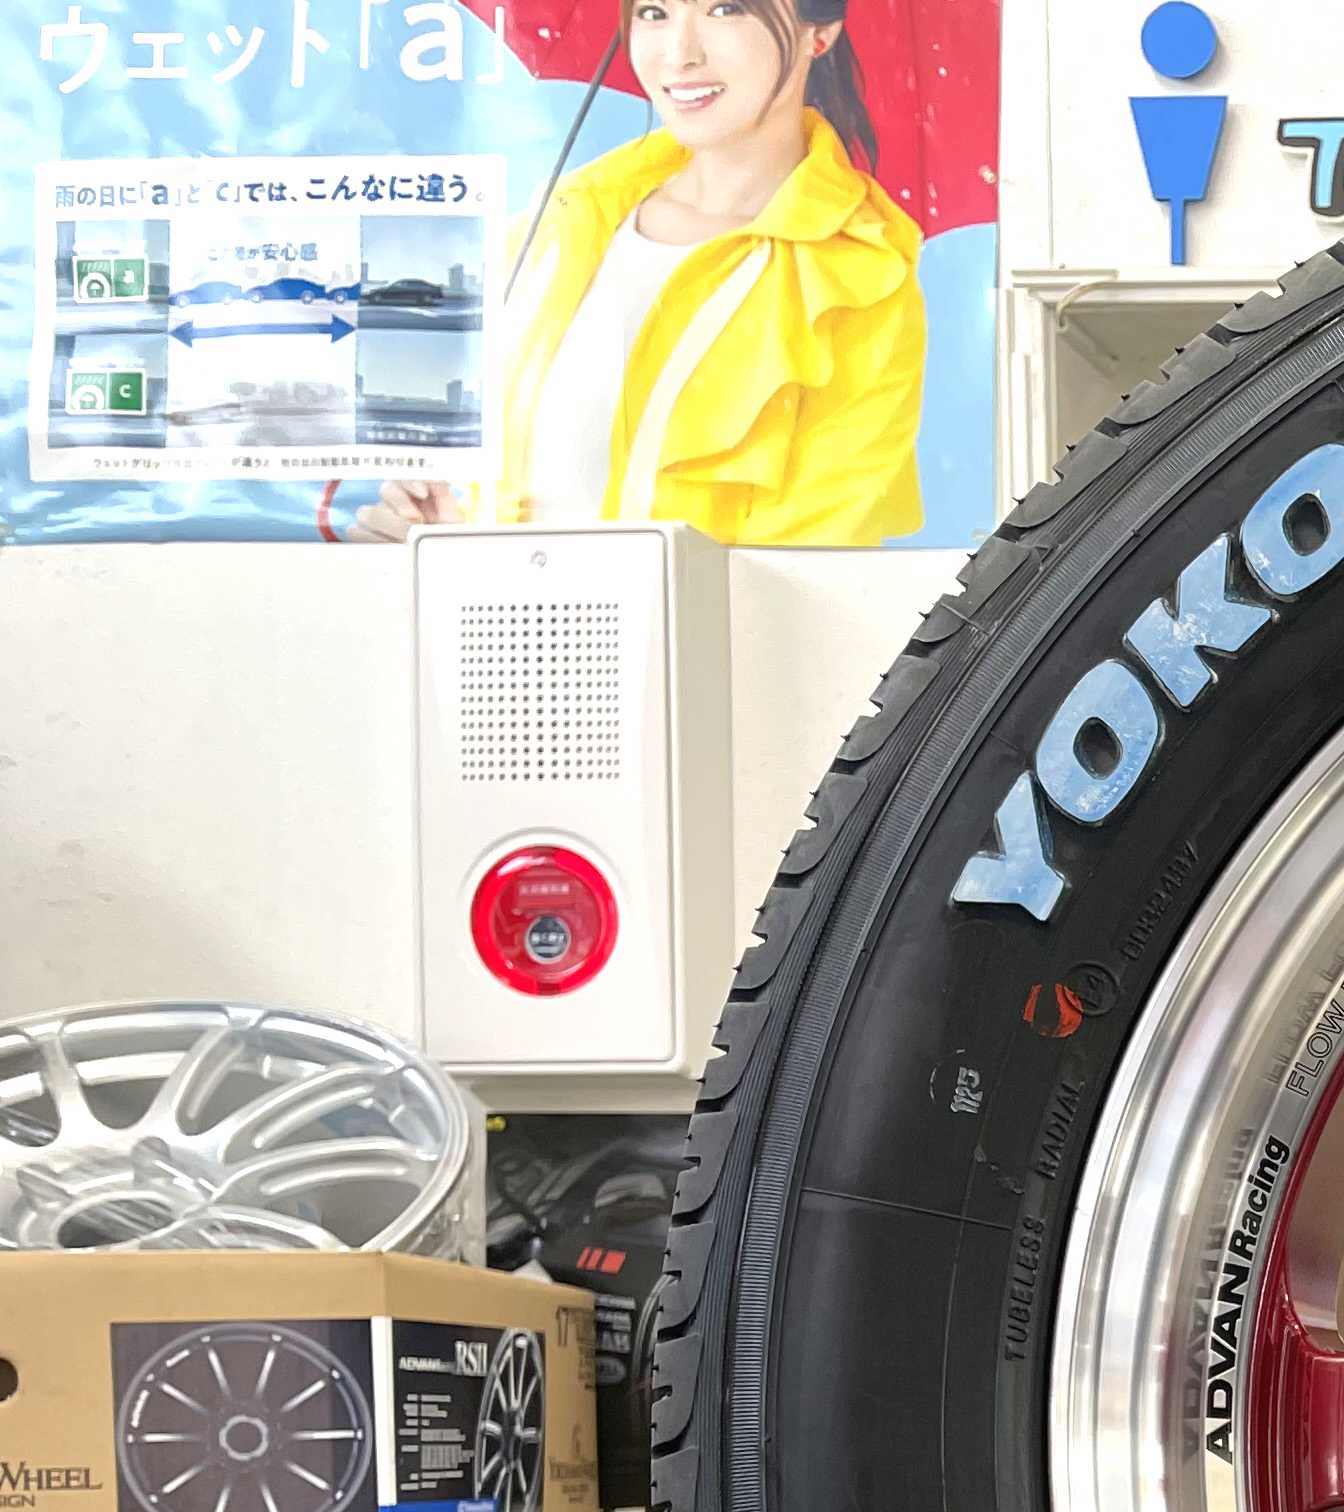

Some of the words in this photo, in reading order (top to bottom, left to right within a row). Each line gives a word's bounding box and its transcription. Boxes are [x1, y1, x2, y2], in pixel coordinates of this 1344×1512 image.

[1004, 1217, 1046, 1361] TUBELESS
[1036, 1078, 1087, 1180] RADIAL
[1228, 1134, 1291, 1263] Racing
[1206, 1262, 1251, 1465] ADVAN
